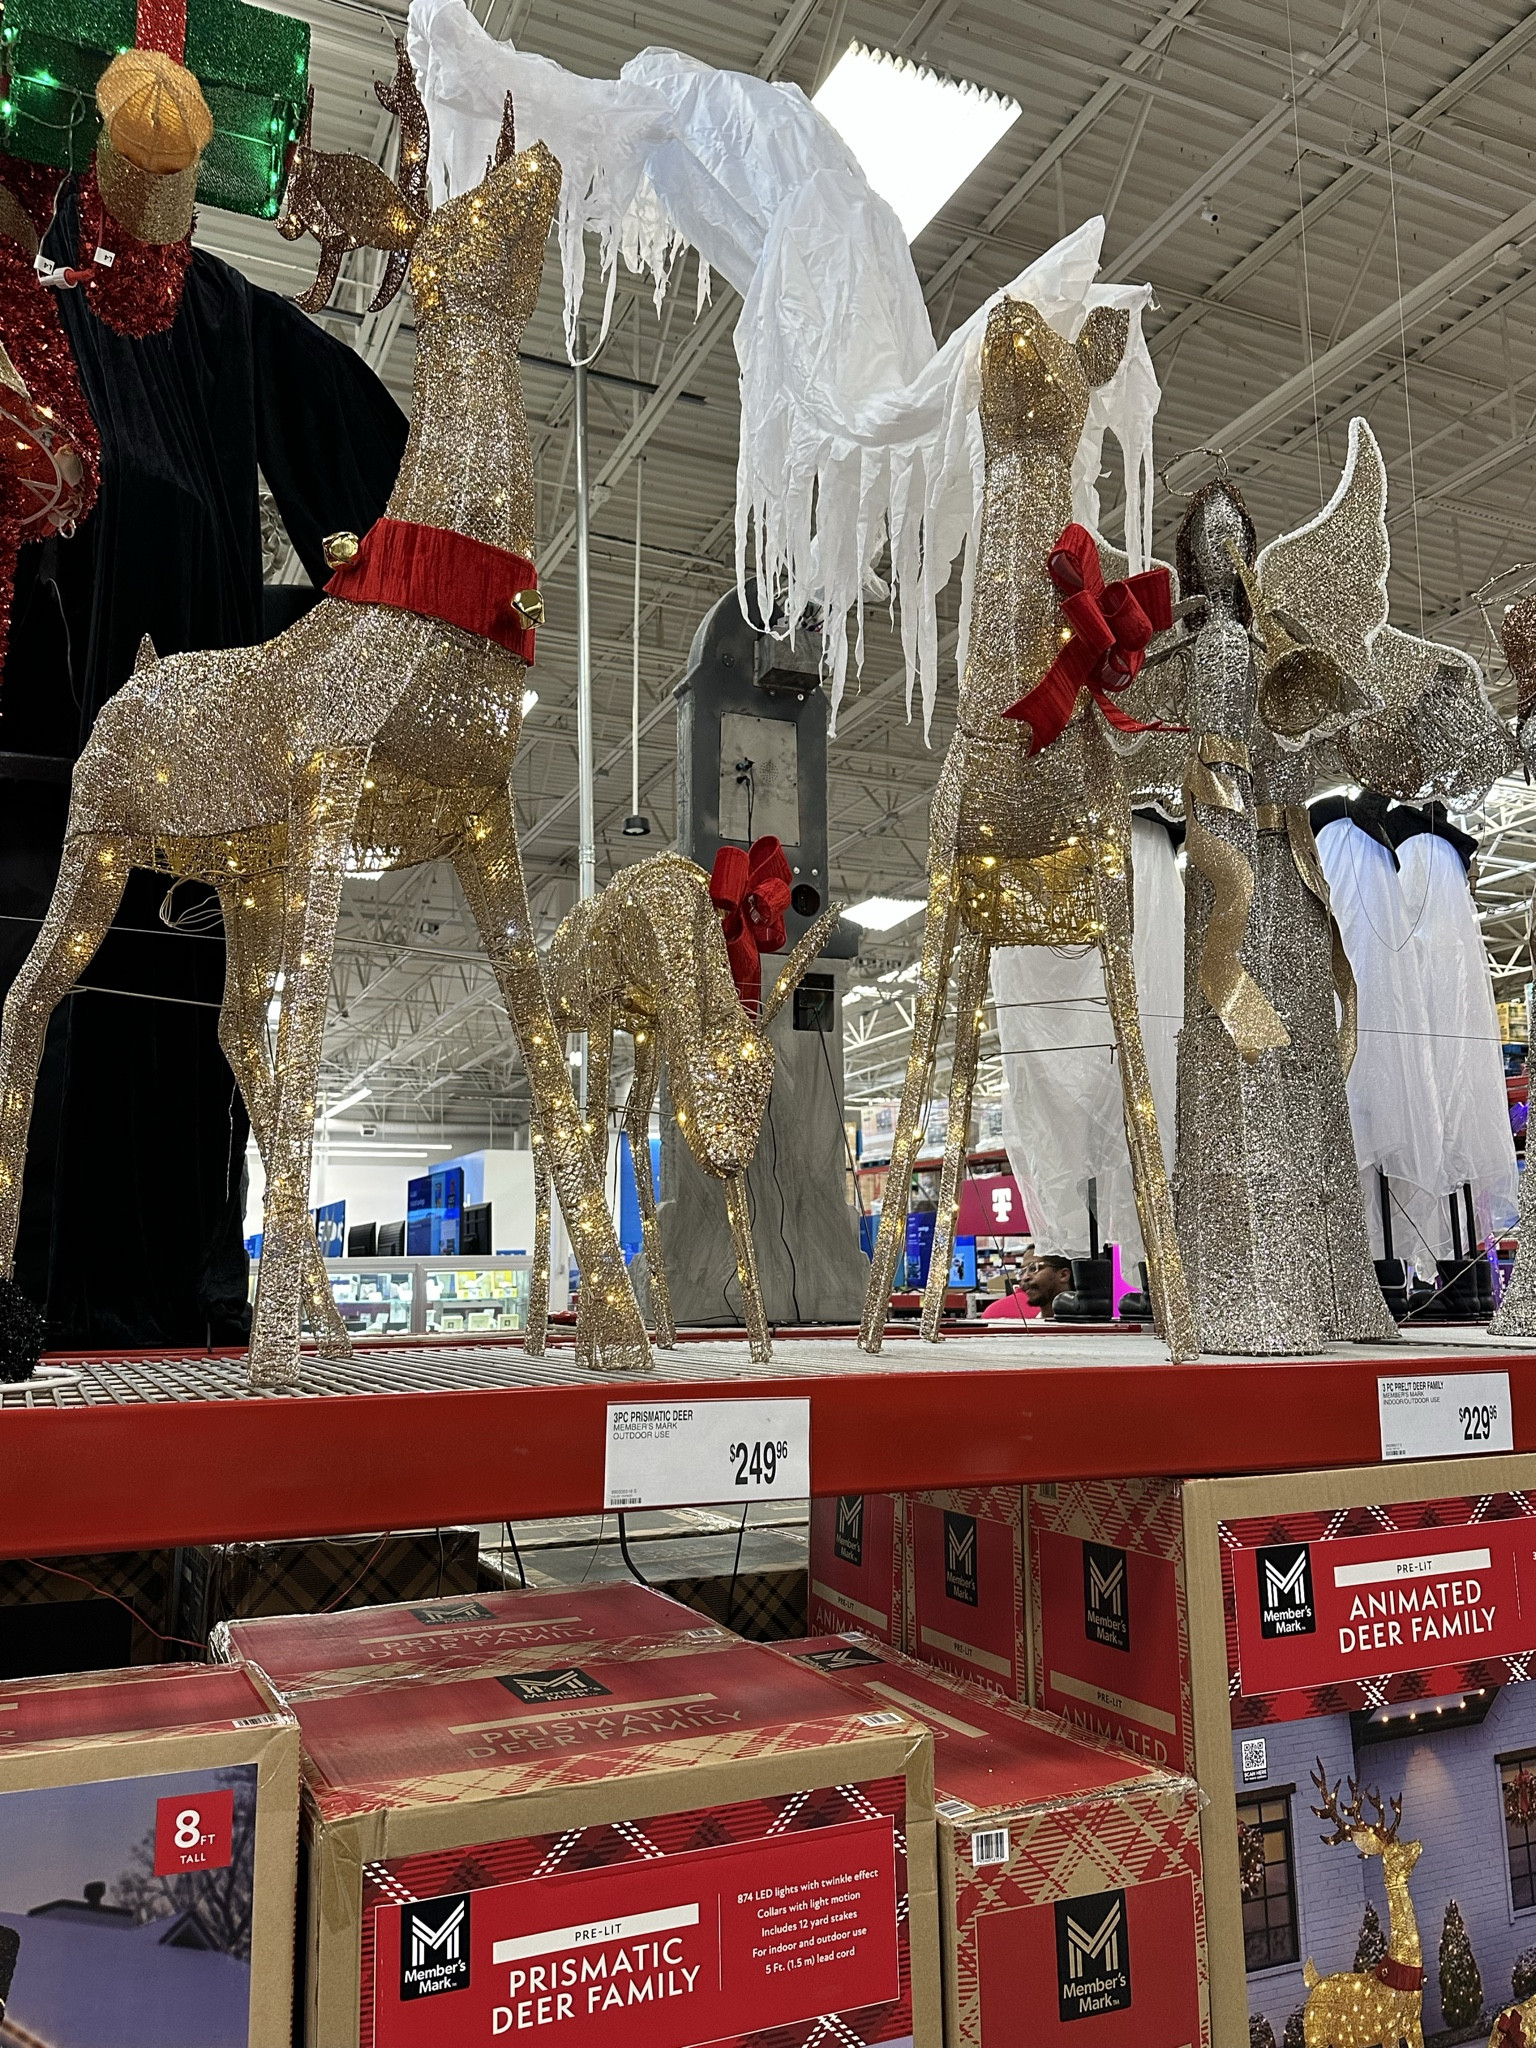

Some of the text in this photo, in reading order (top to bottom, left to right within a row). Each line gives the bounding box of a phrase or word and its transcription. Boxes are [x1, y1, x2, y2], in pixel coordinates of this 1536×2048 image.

[1413, 1381, 1427, 1391] DEER
[1427, 1381, 1444, 1390] FAMILY
[613, 1409, 694, 1423] 3PC PRISMATIC DEER
[613, 1422, 678, 1431] MEMBER'S MARK
[613, 1430, 670, 1440] OUTDOOR USE
[836, 1533, 861, 1553] Member's
[1396, 1561, 1433, 1574] PRE-LIT
[946, 1571, 976, 1591] Member's
[1349, 1579, 1482, 1621] ANIMATED
[1087, 1610, 1127, 1633] Member's
[1263, 1605, 1312, 1623] Member's
[384, 1623, 575, 1650] PRISMATIC
[1338, 1606, 1497, 1654] DEER FAMILY
[368, 1627, 596, 1660] DEER FAMILY
[953, 1642, 973, 1658] PRE-LIT
[523, 1686, 602, 1701] Member's
[1097, 1691, 1123, 1709] PRE-LIT
[481, 1704, 715, 1745] PRISMATIC
[560, 1707, 615, 1718] PRE-LIT
[465, 1710, 744, 1759] DEER FAMILY
[1062, 1704, 1168, 1765] ANIMATED
[180, 1853, 206, 1865] TALL
[737, 1869, 879, 1904] 874 LED lights with twinkle effect
[757, 1892, 861, 1919] Collars with light motion
[574, 1923, 623, 1942] PRE-LIT
[761, 1910, 858, 1937] Includes 12 yard stakes
[752, 1927, 868, 1958] For indoor and outdoor use
[404, 1958, 467, 1984] Member's
[509, 1937, 683, 1998] PRISMATIC
[765, 1946, 856, 1975] 5 Ft. (1.5 m) lead cord
[1063, 1972, 1127, 1999] Member's
[492, 1964, 701, 2036] DEER FAMILY
